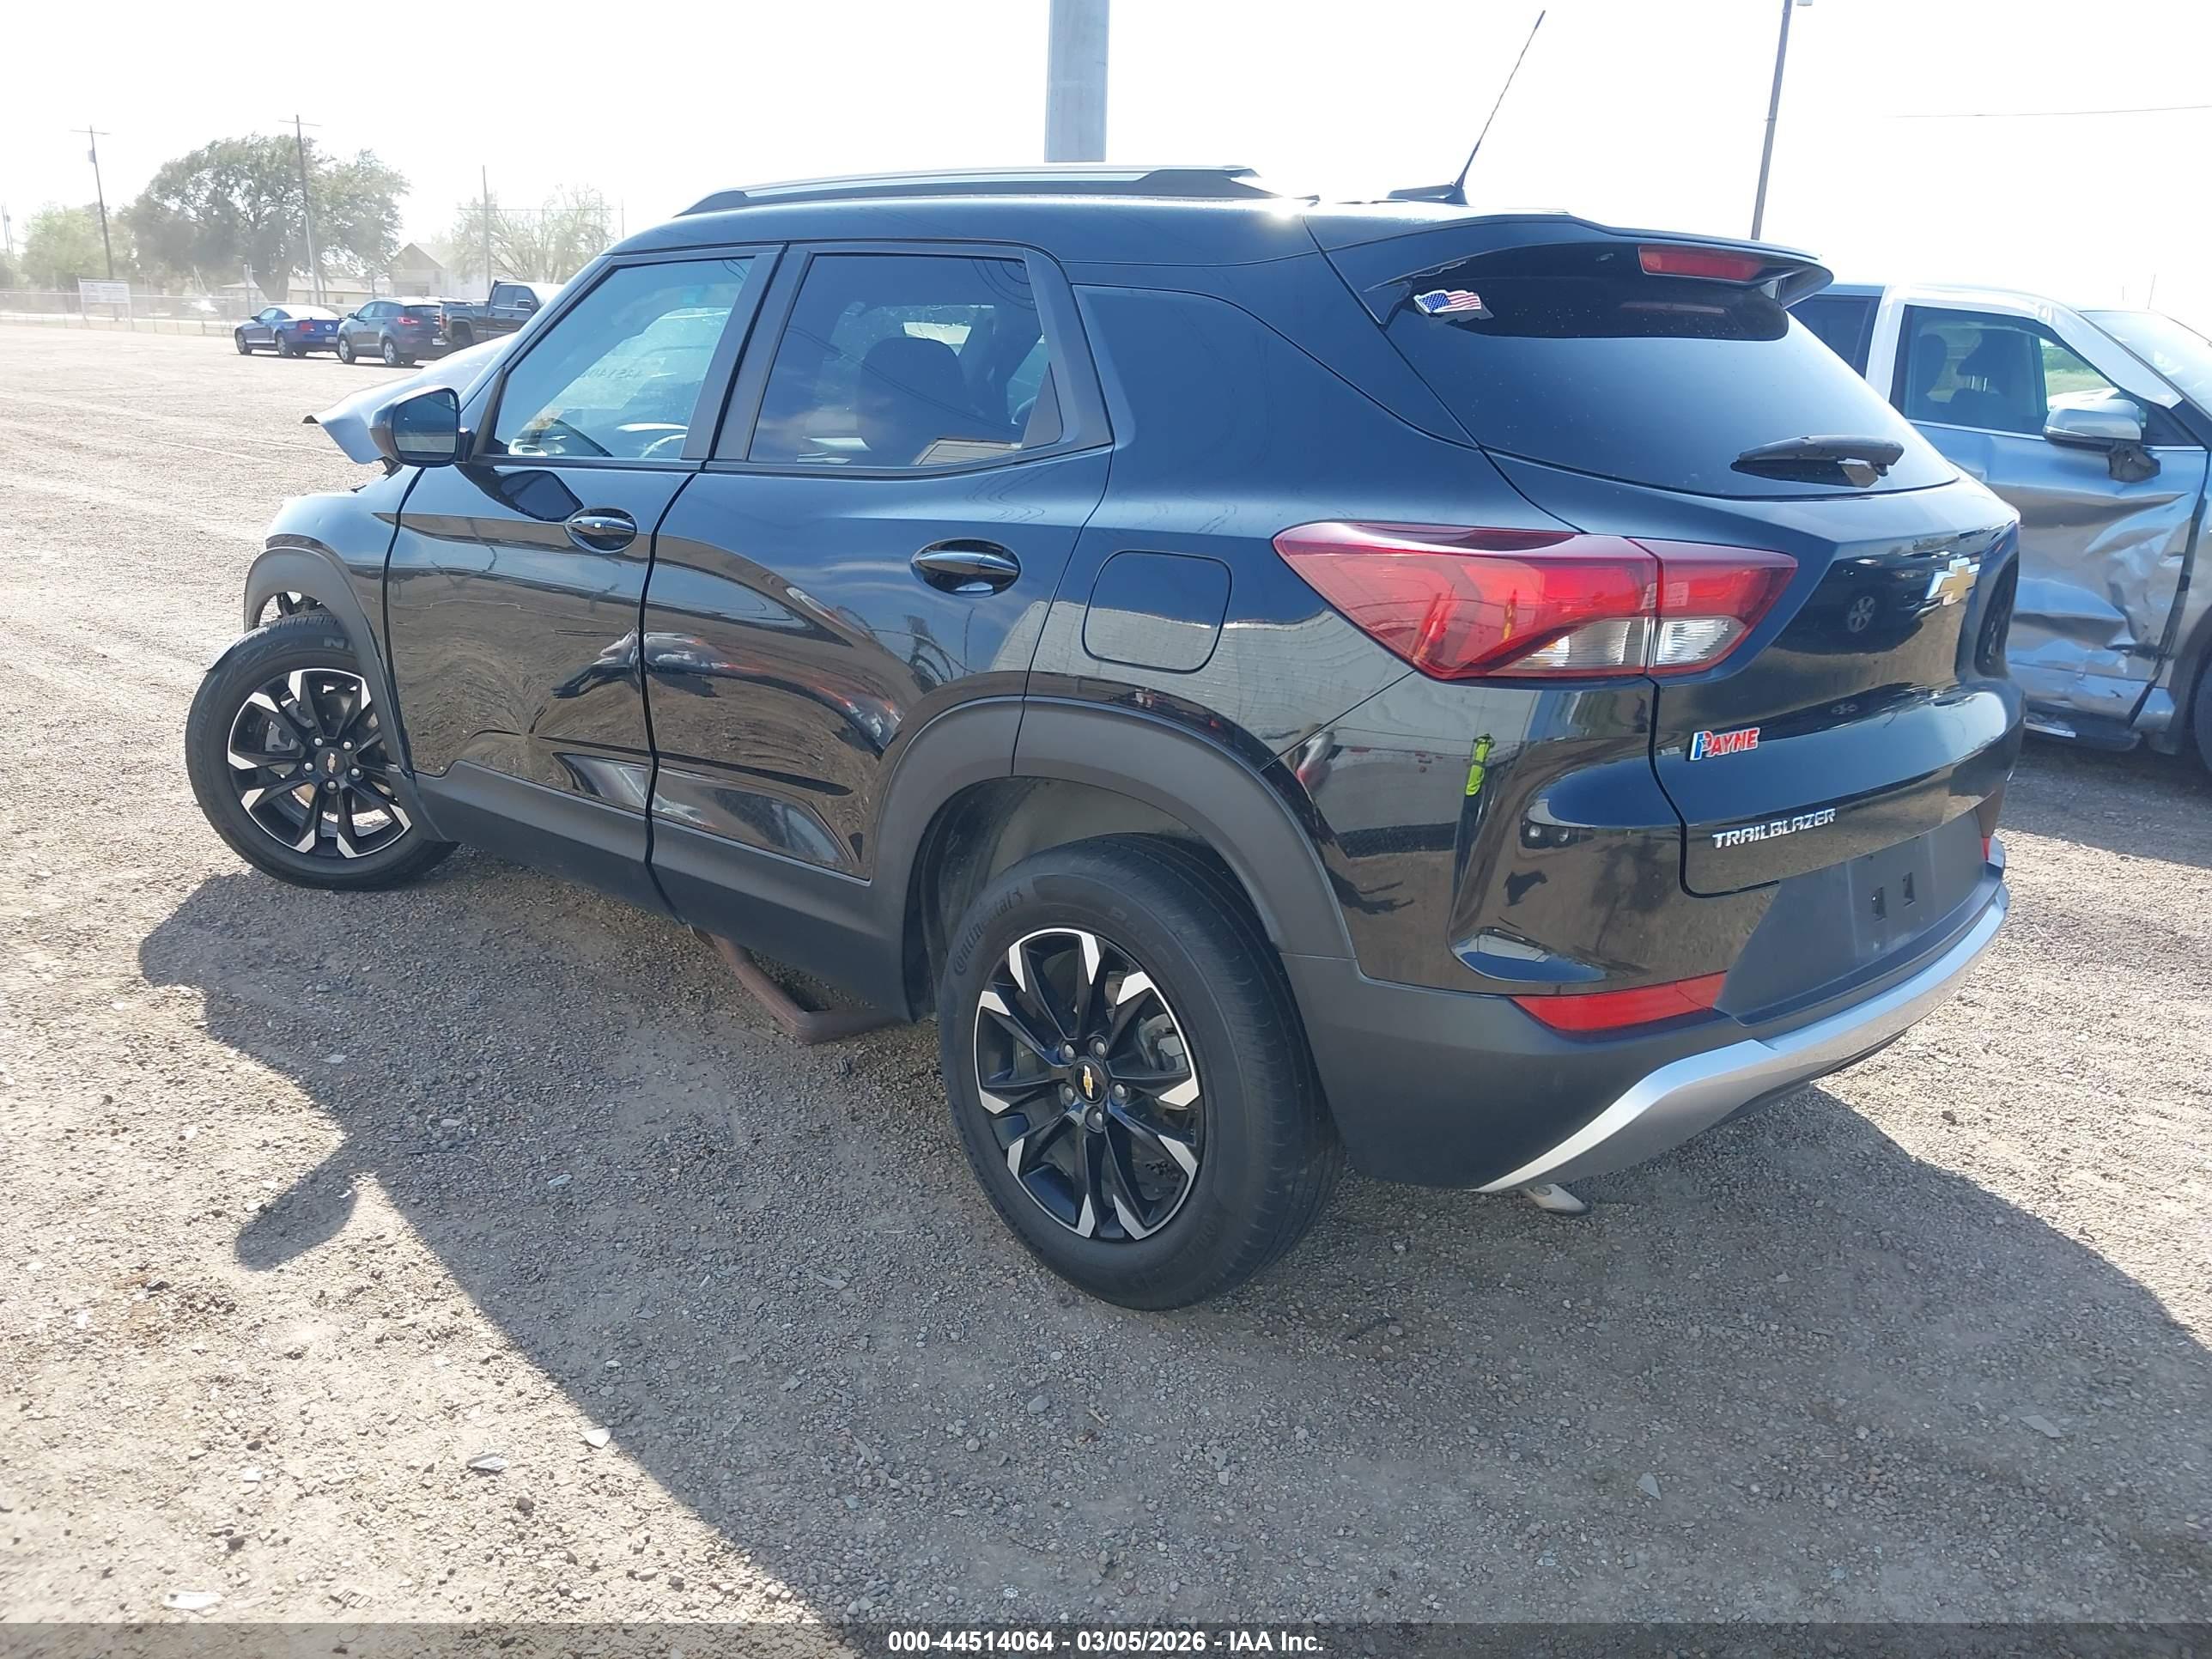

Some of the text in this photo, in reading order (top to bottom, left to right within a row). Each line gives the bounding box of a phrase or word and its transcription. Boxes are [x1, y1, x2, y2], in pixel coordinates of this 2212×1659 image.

[1690, 727, 1760, 761] PAYNE
[1711, 807, 1837, 849] TRAILBLAZER
[954, 890, 1014, 976] Contintal
